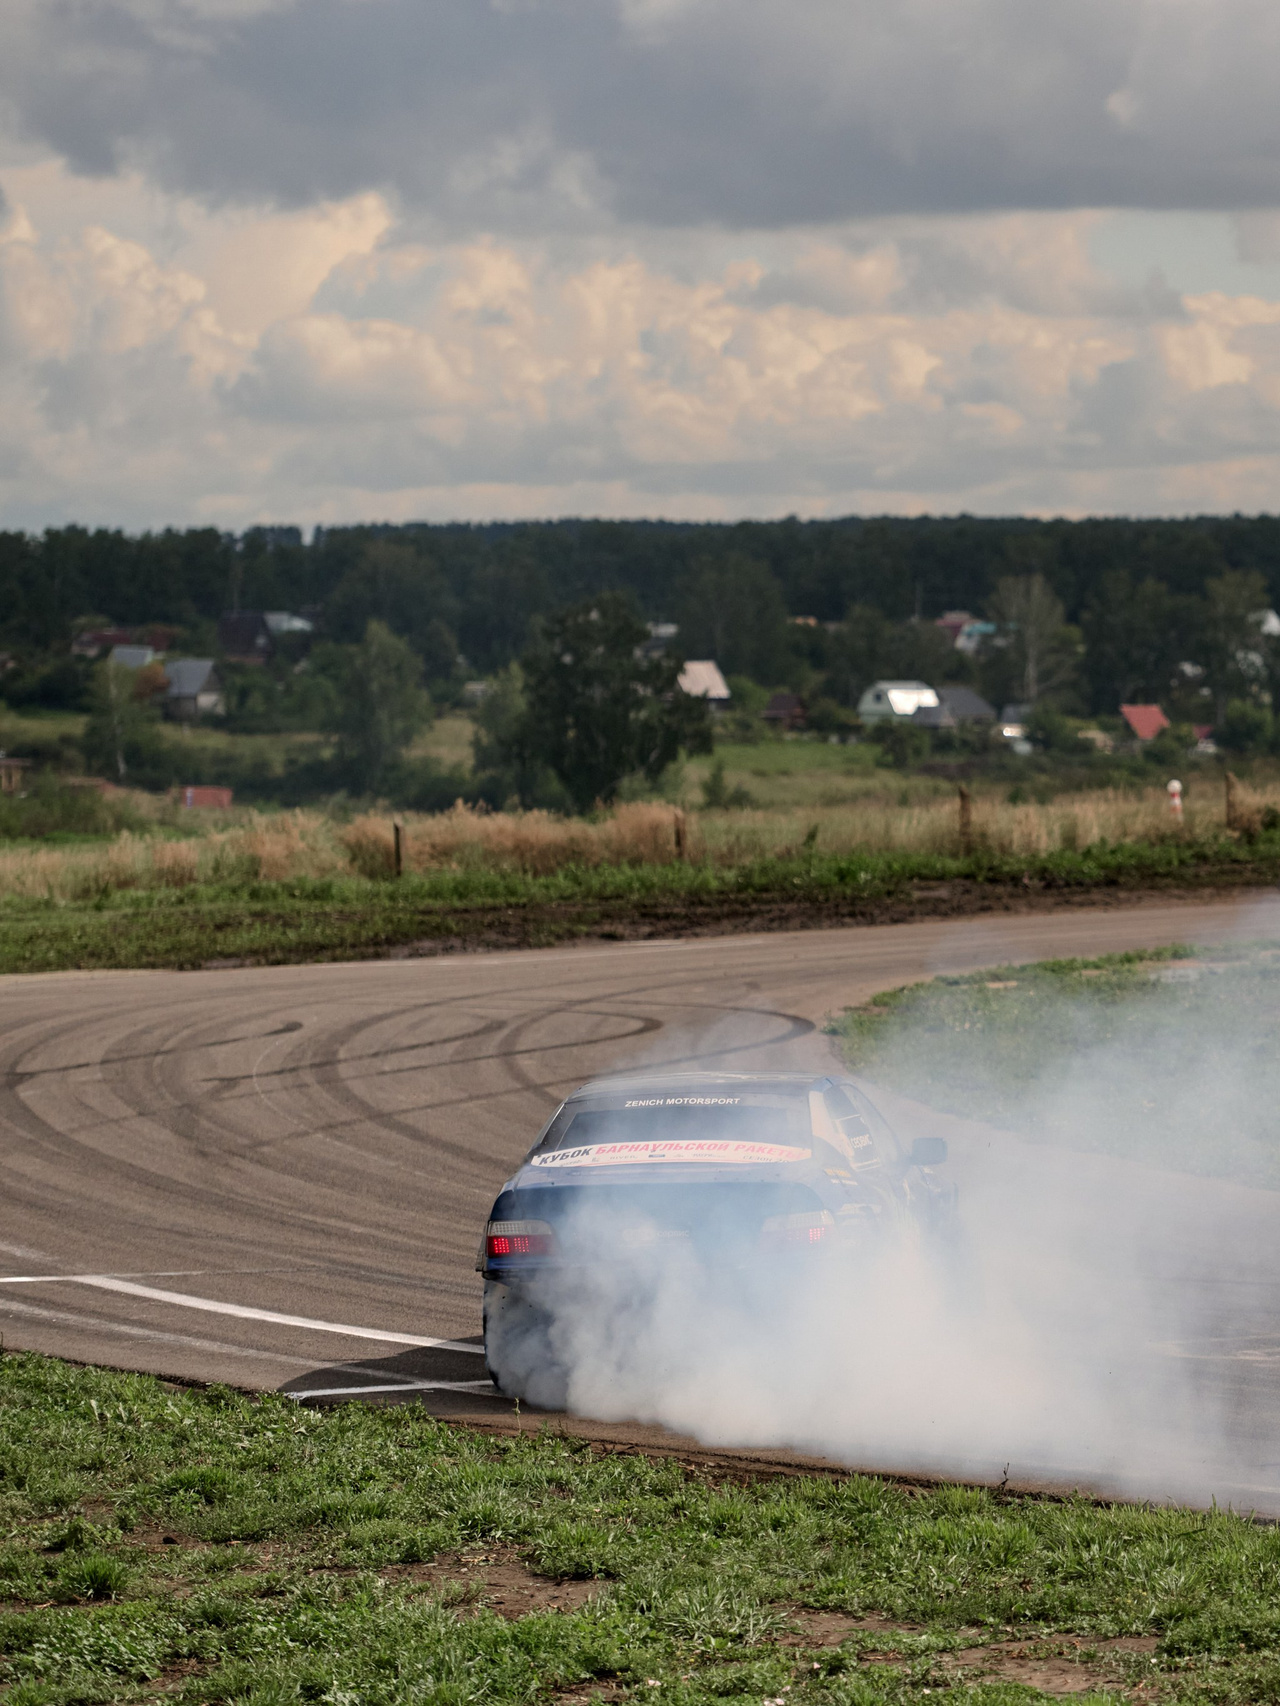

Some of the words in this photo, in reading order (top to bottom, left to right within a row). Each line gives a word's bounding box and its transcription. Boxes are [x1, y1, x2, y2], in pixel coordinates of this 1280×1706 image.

[625, 1099, 663, 1107] ZENICH
[666, 1097, 740, 1105] MOTORSPORT
[539, 1147, 593, 1165] КУБОК
[595, 1142, 730, 1155] БАРНАУЛЬСКОЙ
